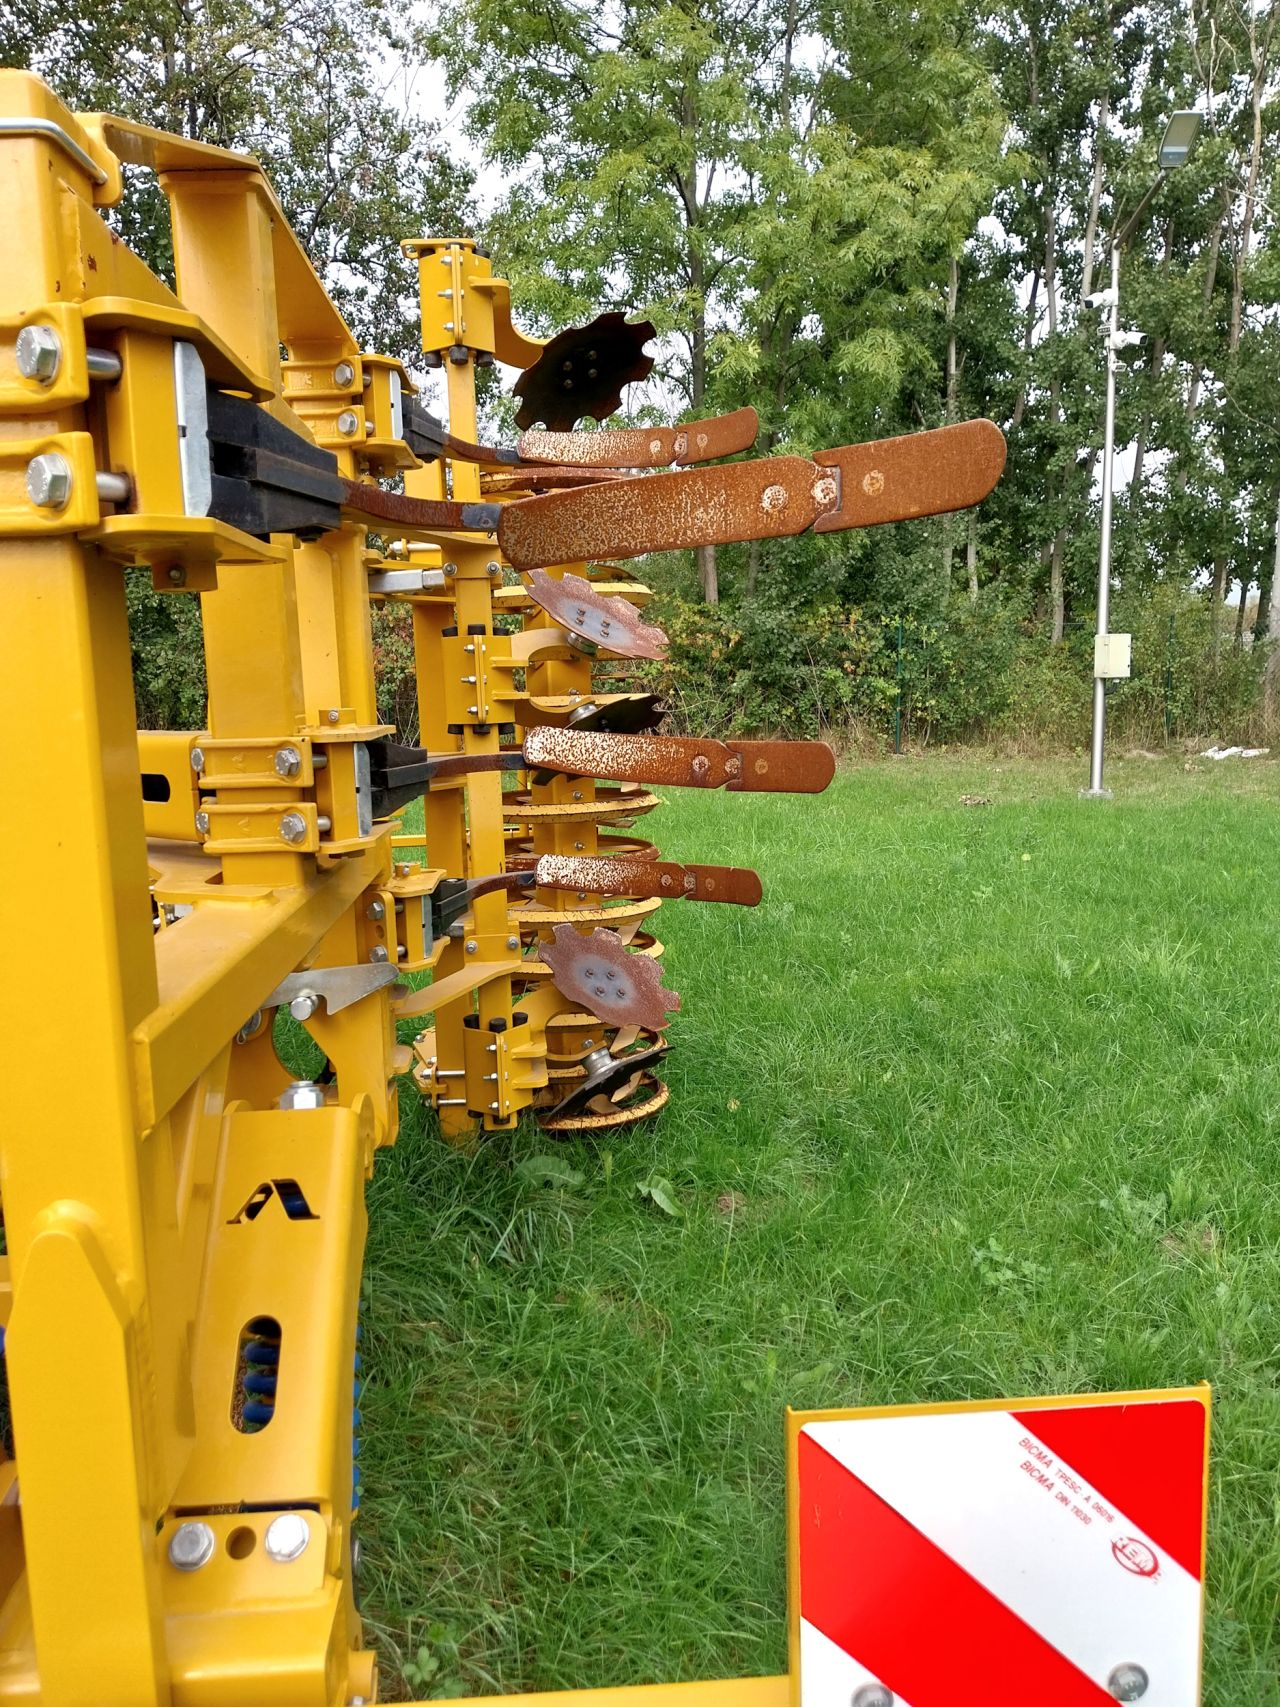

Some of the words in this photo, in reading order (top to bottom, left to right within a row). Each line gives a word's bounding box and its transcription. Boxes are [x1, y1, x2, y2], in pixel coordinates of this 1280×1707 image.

[1018, 1437, 1053, 1468] BICMA
[1020, 1460, 1055, 1492] BICMA
[1055, 1491, 1071, 1506] DIN
